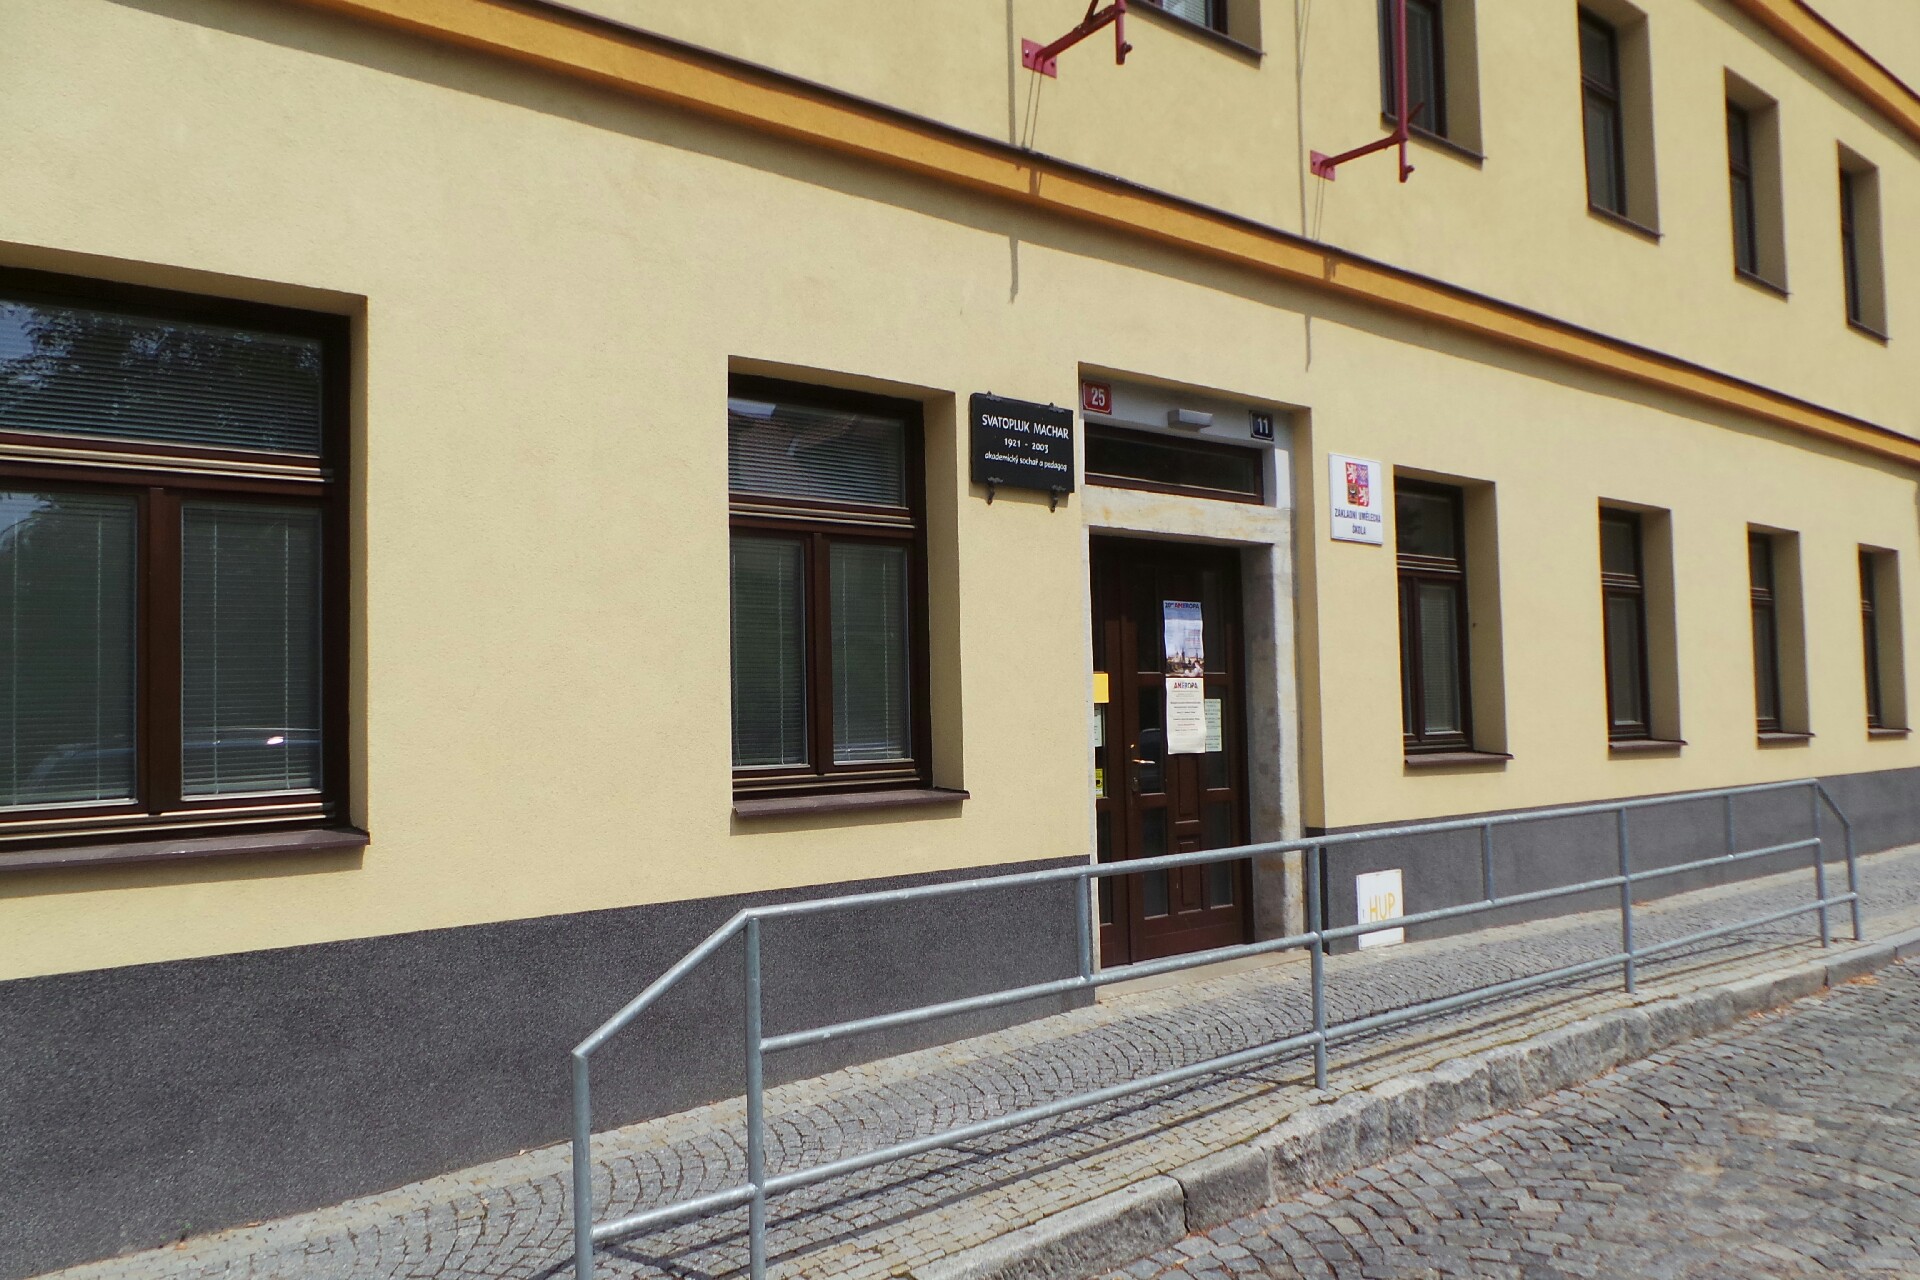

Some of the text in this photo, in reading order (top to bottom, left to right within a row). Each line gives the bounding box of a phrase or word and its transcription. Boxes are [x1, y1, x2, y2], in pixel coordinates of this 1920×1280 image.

[1091, 388, 1105, 406] 25
[982, 414, 1069, 439] SVATOPLUK MACHAR
[1257, 418, 1269, 434] 11
[1004, 438, 1021, 448] 1921
[1031, 442, 1049, 454] 2003
[984, 451, 1019, 464] akademický
[1044, 460, 1068, 472] pedagog
[1369, 892, 1395, 921] HUP
